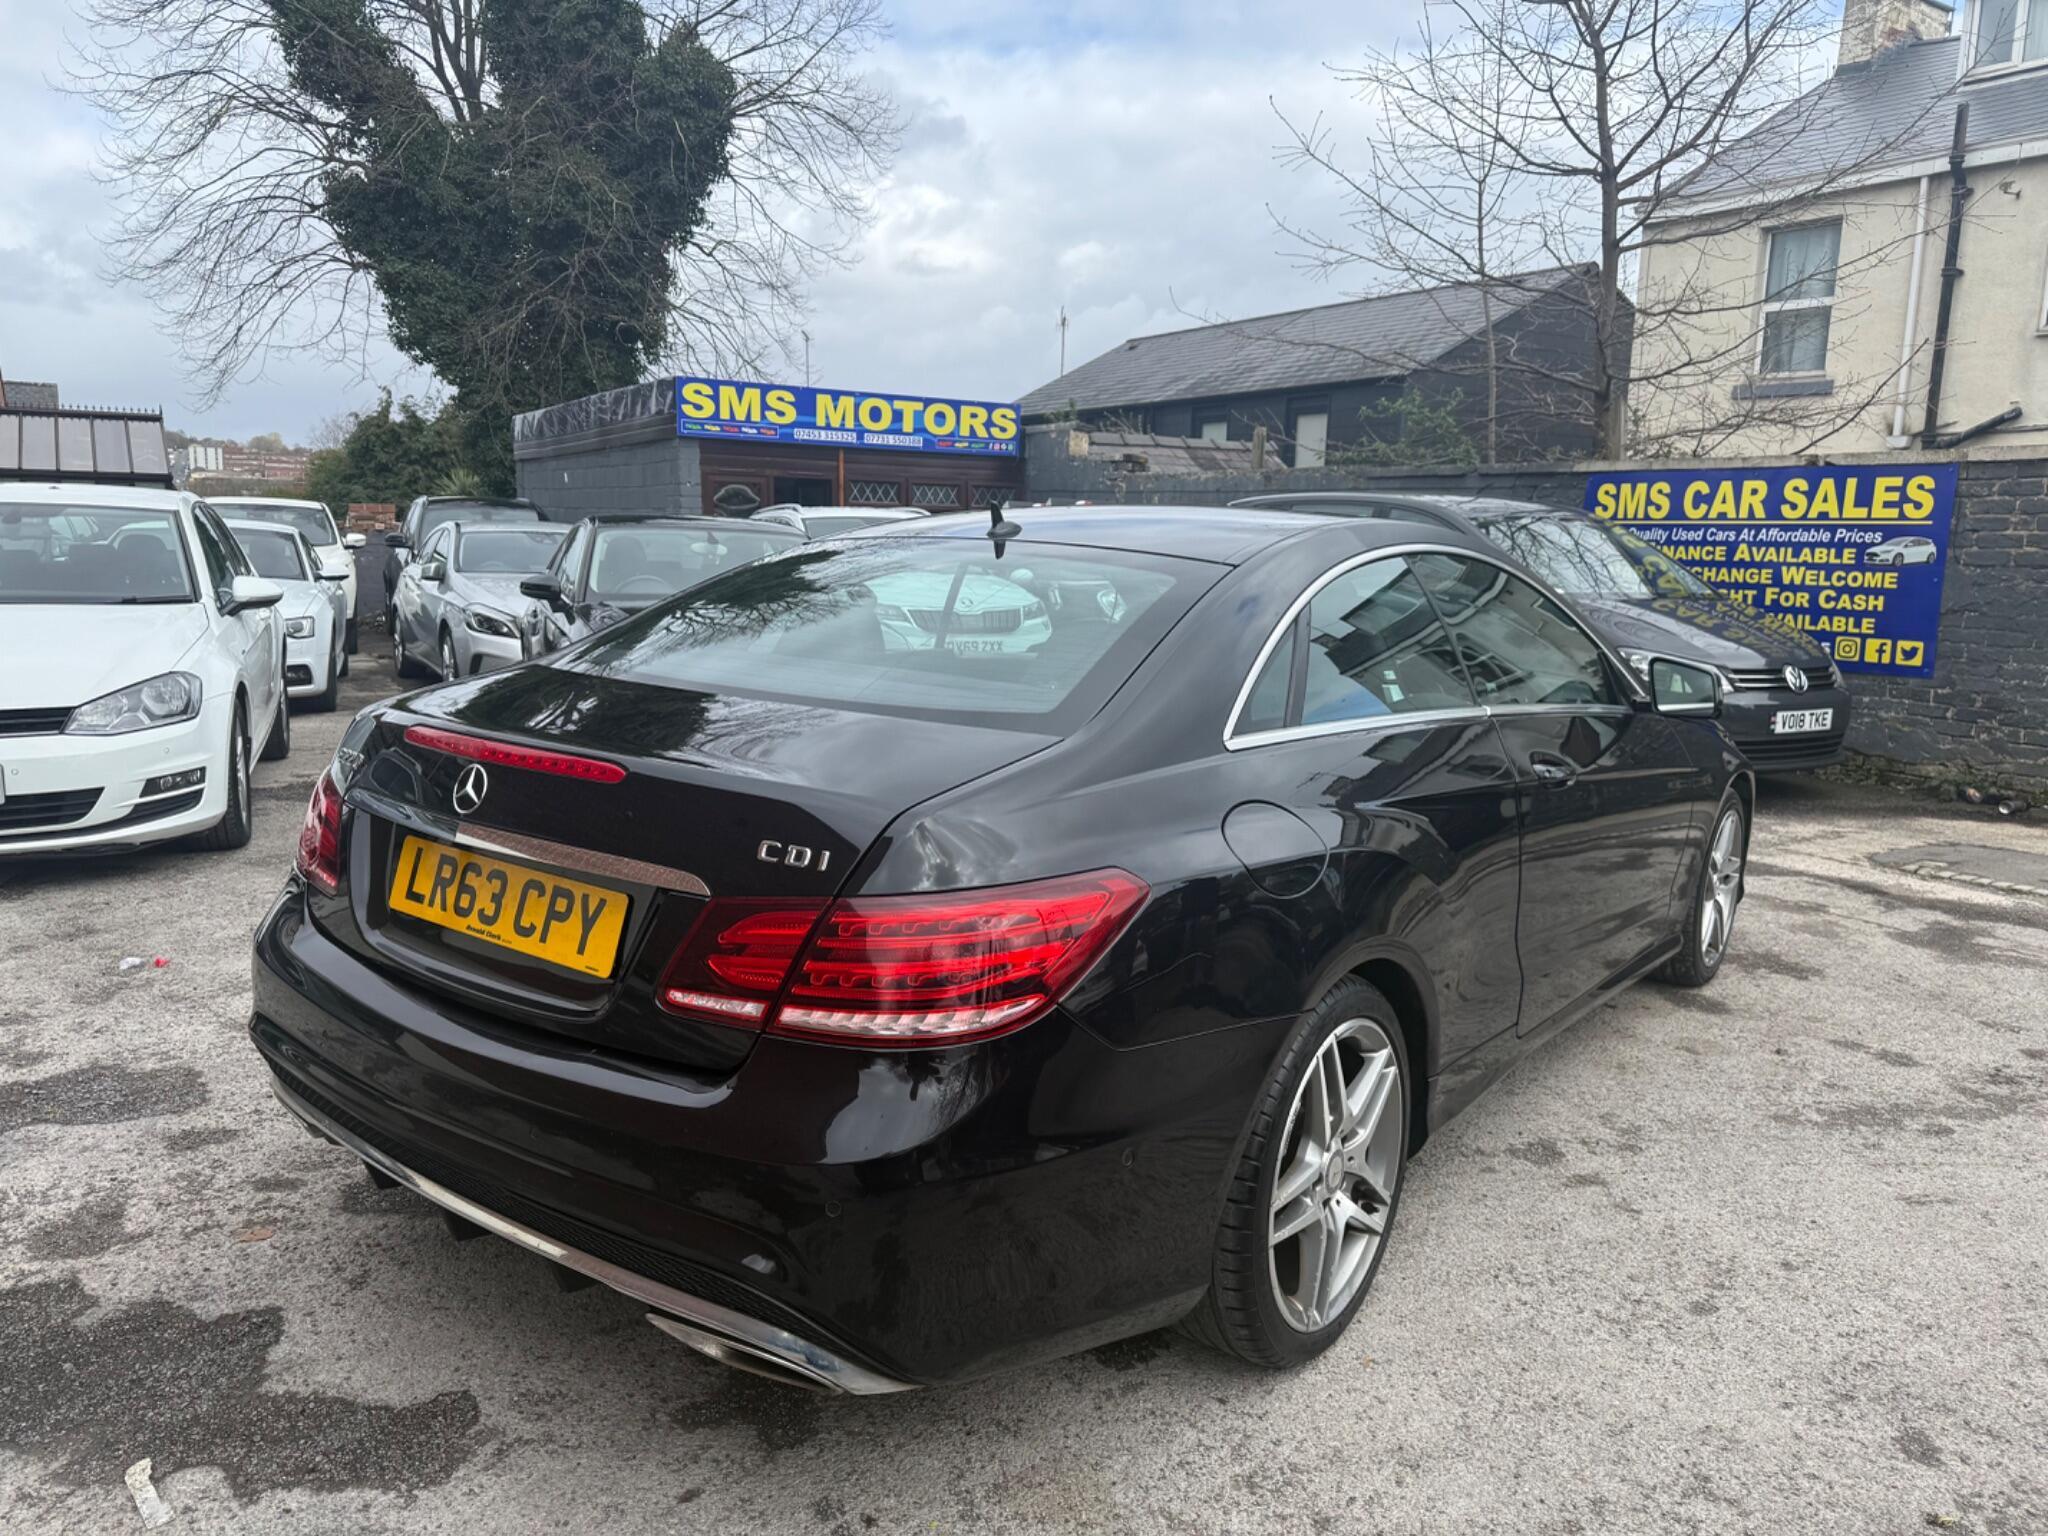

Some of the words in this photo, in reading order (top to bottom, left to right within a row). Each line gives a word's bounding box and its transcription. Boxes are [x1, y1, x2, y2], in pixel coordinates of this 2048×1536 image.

[681, 382, 797, 425] SMS
[816, 393, 1017, 439] MOTORS
[1594, 482, 1671, 519] SMS
[1683, 480, 1769, 519] CAR
[1781, 475, 1936, 520] SALES
[1671, 527, 1704, 541] Used
[1706, 527, 1736, 542] Cars
[1738, 528, 1754, 542] At
[1756, 527, 1831, 543] Affordable
[1834, 528, 1883, 543] Prices
[1652, 542, 1727, 561] NANCE
[1733, 543, 1856, 565] AVAILABLE
[1688, 566, 1773, 584] CHANGE
[1781, 566, 1898, 589] WELCOME
[1764, 587, 1809, 608] FOR
[1818, 589, 1885, 612] CASH
[1778, 613, 1876, 634] AILABLE
[1808, 711, 1829, 728] TKE
[757, 840, 830, 872] CDI
[405, 846, 509, 927] LR63
[513, 878, 608, 956] CPY
